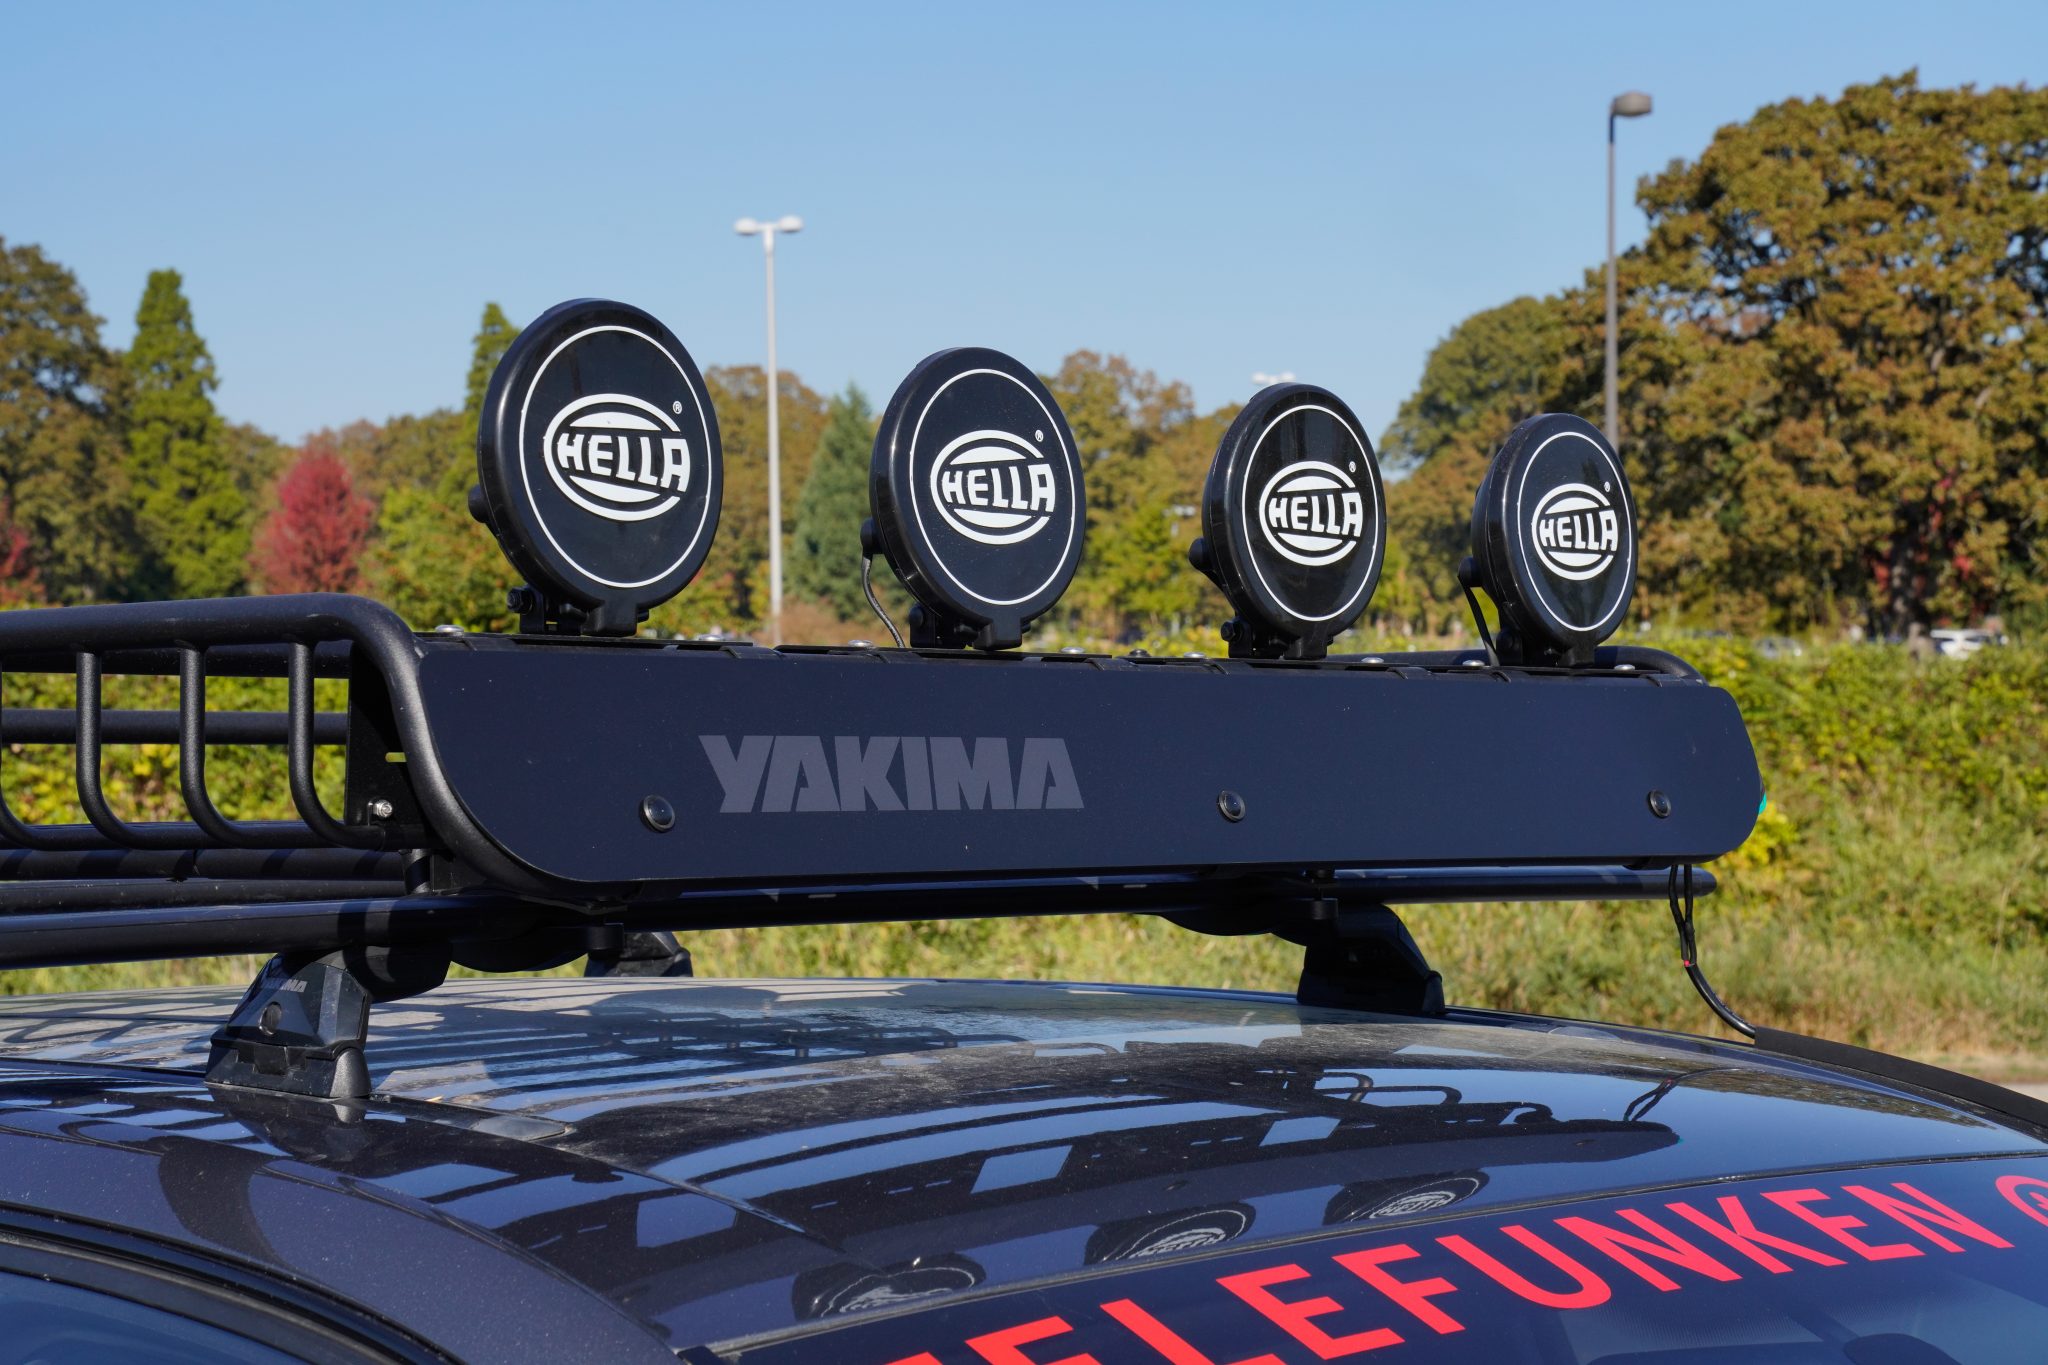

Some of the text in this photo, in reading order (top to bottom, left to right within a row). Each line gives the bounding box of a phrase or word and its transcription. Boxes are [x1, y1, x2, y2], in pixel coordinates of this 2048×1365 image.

[556, 432, 691, 493] HELLA
[941, 463, 1056, 513] HELLA
[1268, 492, 1364, 537] HELLA
[1538, 509, 1619, 552] HELLA
[699, 735, 1085, 813] YAKIMA
[886, 1183, 2015, 1365] LEFUNKEN
